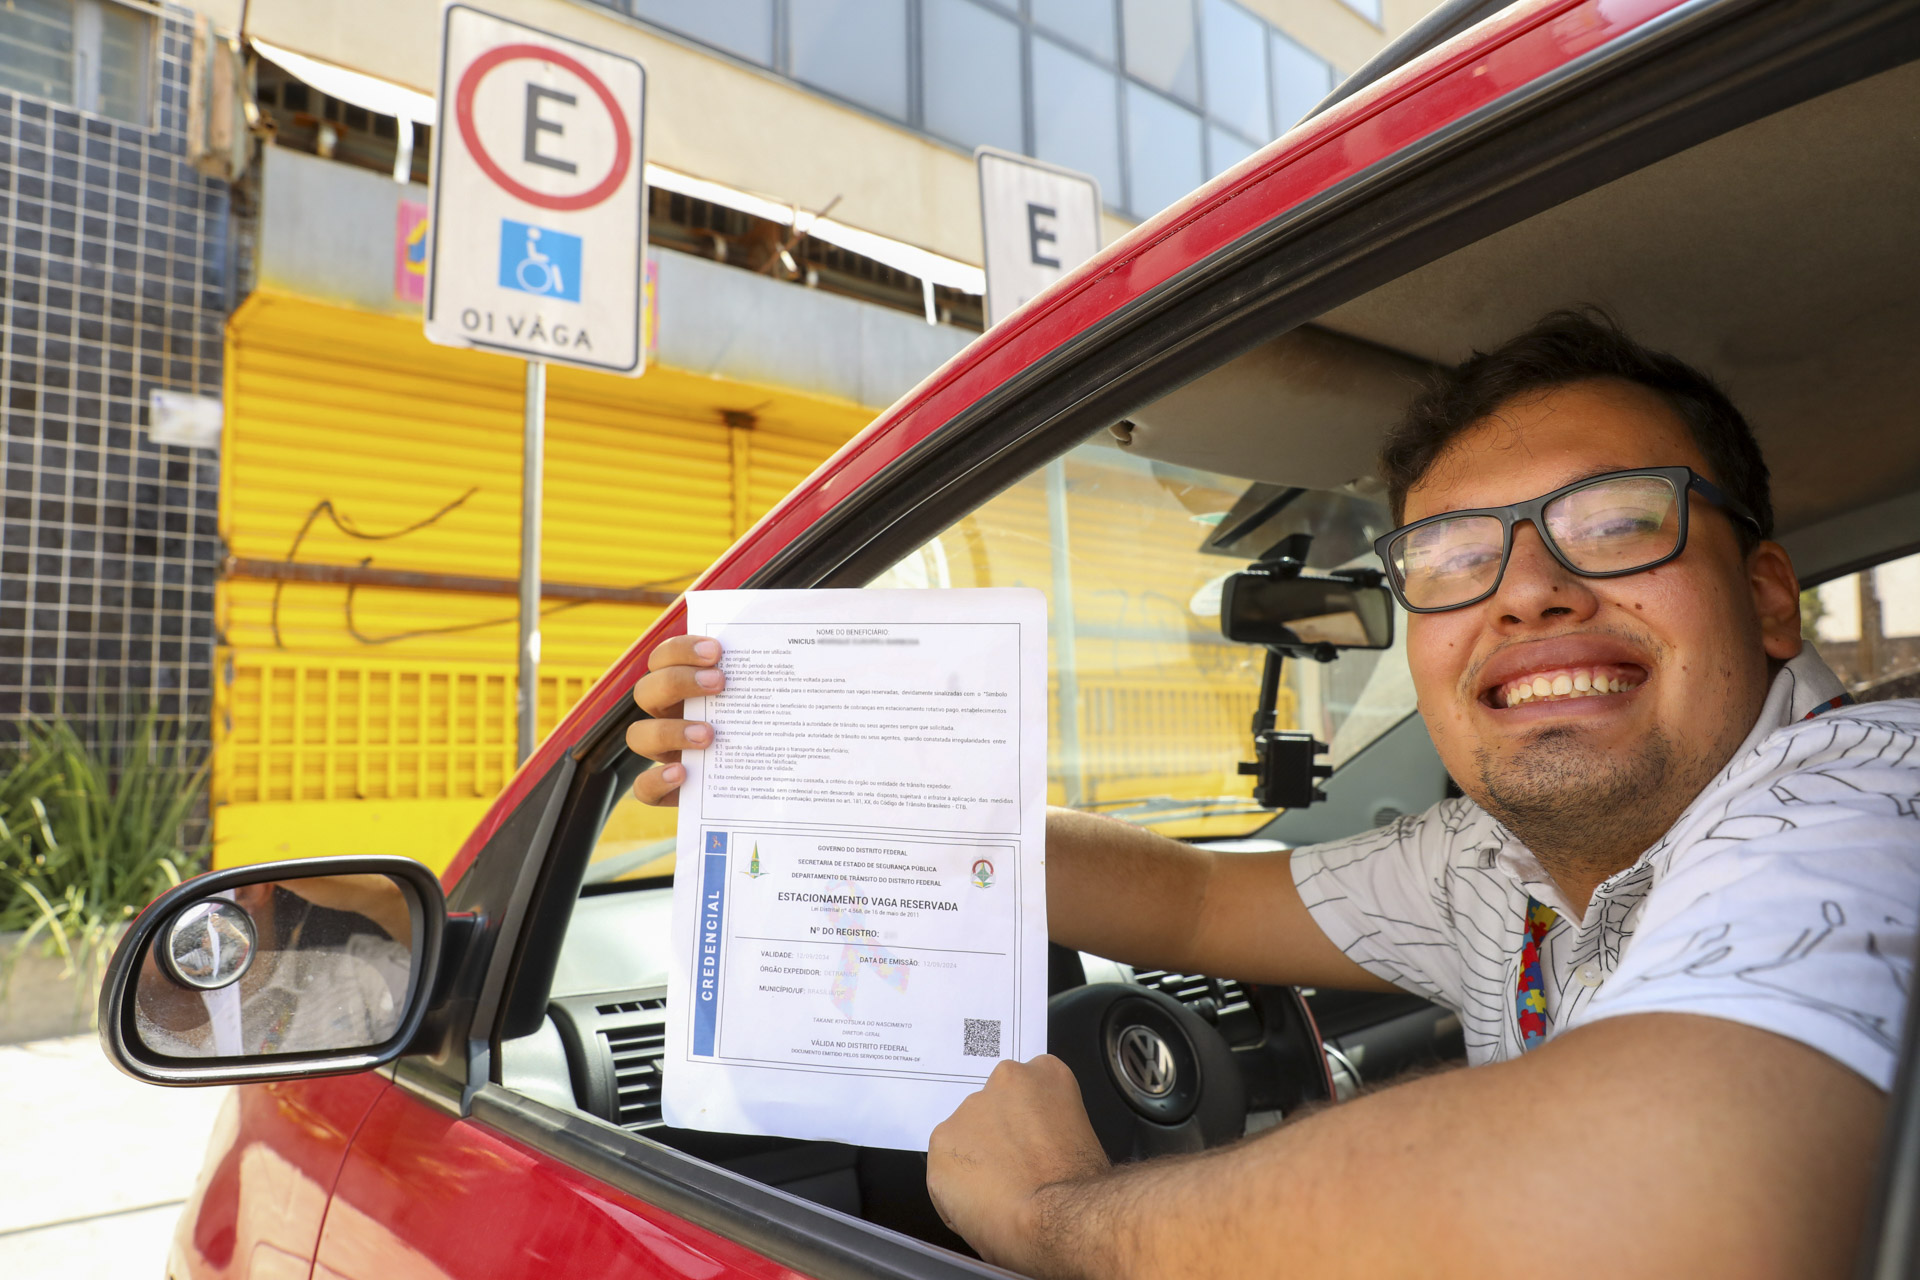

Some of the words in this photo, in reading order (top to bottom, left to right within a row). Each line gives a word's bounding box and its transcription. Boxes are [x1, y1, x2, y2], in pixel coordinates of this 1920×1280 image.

[523, 82, 577, 175] E
[1027, 202, 1060, 269] E
[508, 315, 593, 350] VAGA
[883, 848, 908, 856] FEDERAL
[798, 858, 833, 866] SECRETARIA
[843, 860, 866, 868] ESTADO
[876, 862, 910, 872] SEGURANÇA
[911, 864, 937, 873] PÚBLICA
[792, 872, 839, 881] DEPARTAMENTO
[848, 874, 878, 883] TRÂNSITO
[888, 877, 915, 885] DISTRITO
[915, 879, 942, 887] FEDERAL
[778, 892, 868, 906] ESTACIONAMENTO
[871, 897, 898, 908] VAGA
[900, 898, 958, 911] RESERVADA
[822, 927, 834, 935] DO
[836, 928, 880, 938] REGISTRO:
[702, 891, 719, 1001] CREDENCIAL
[860, 956, 878, 964] DATA
[888, 958, 919, 966] EMISSÃO:
[760, 965, 783, 974] ÓRGÃO
[783, 967, 821, 975] EXPEDIDOR:
[759, 985, 805, 994] MUNICÍPIO/UF:
[791, 1048, 821, 1056] DOCUMENTO
[811, 1038, 835, 1048] VÁLIDA
[847, 1042, 879, 1050] DISTRITO
[879, 1044, 909, 1052] FEDERAL
